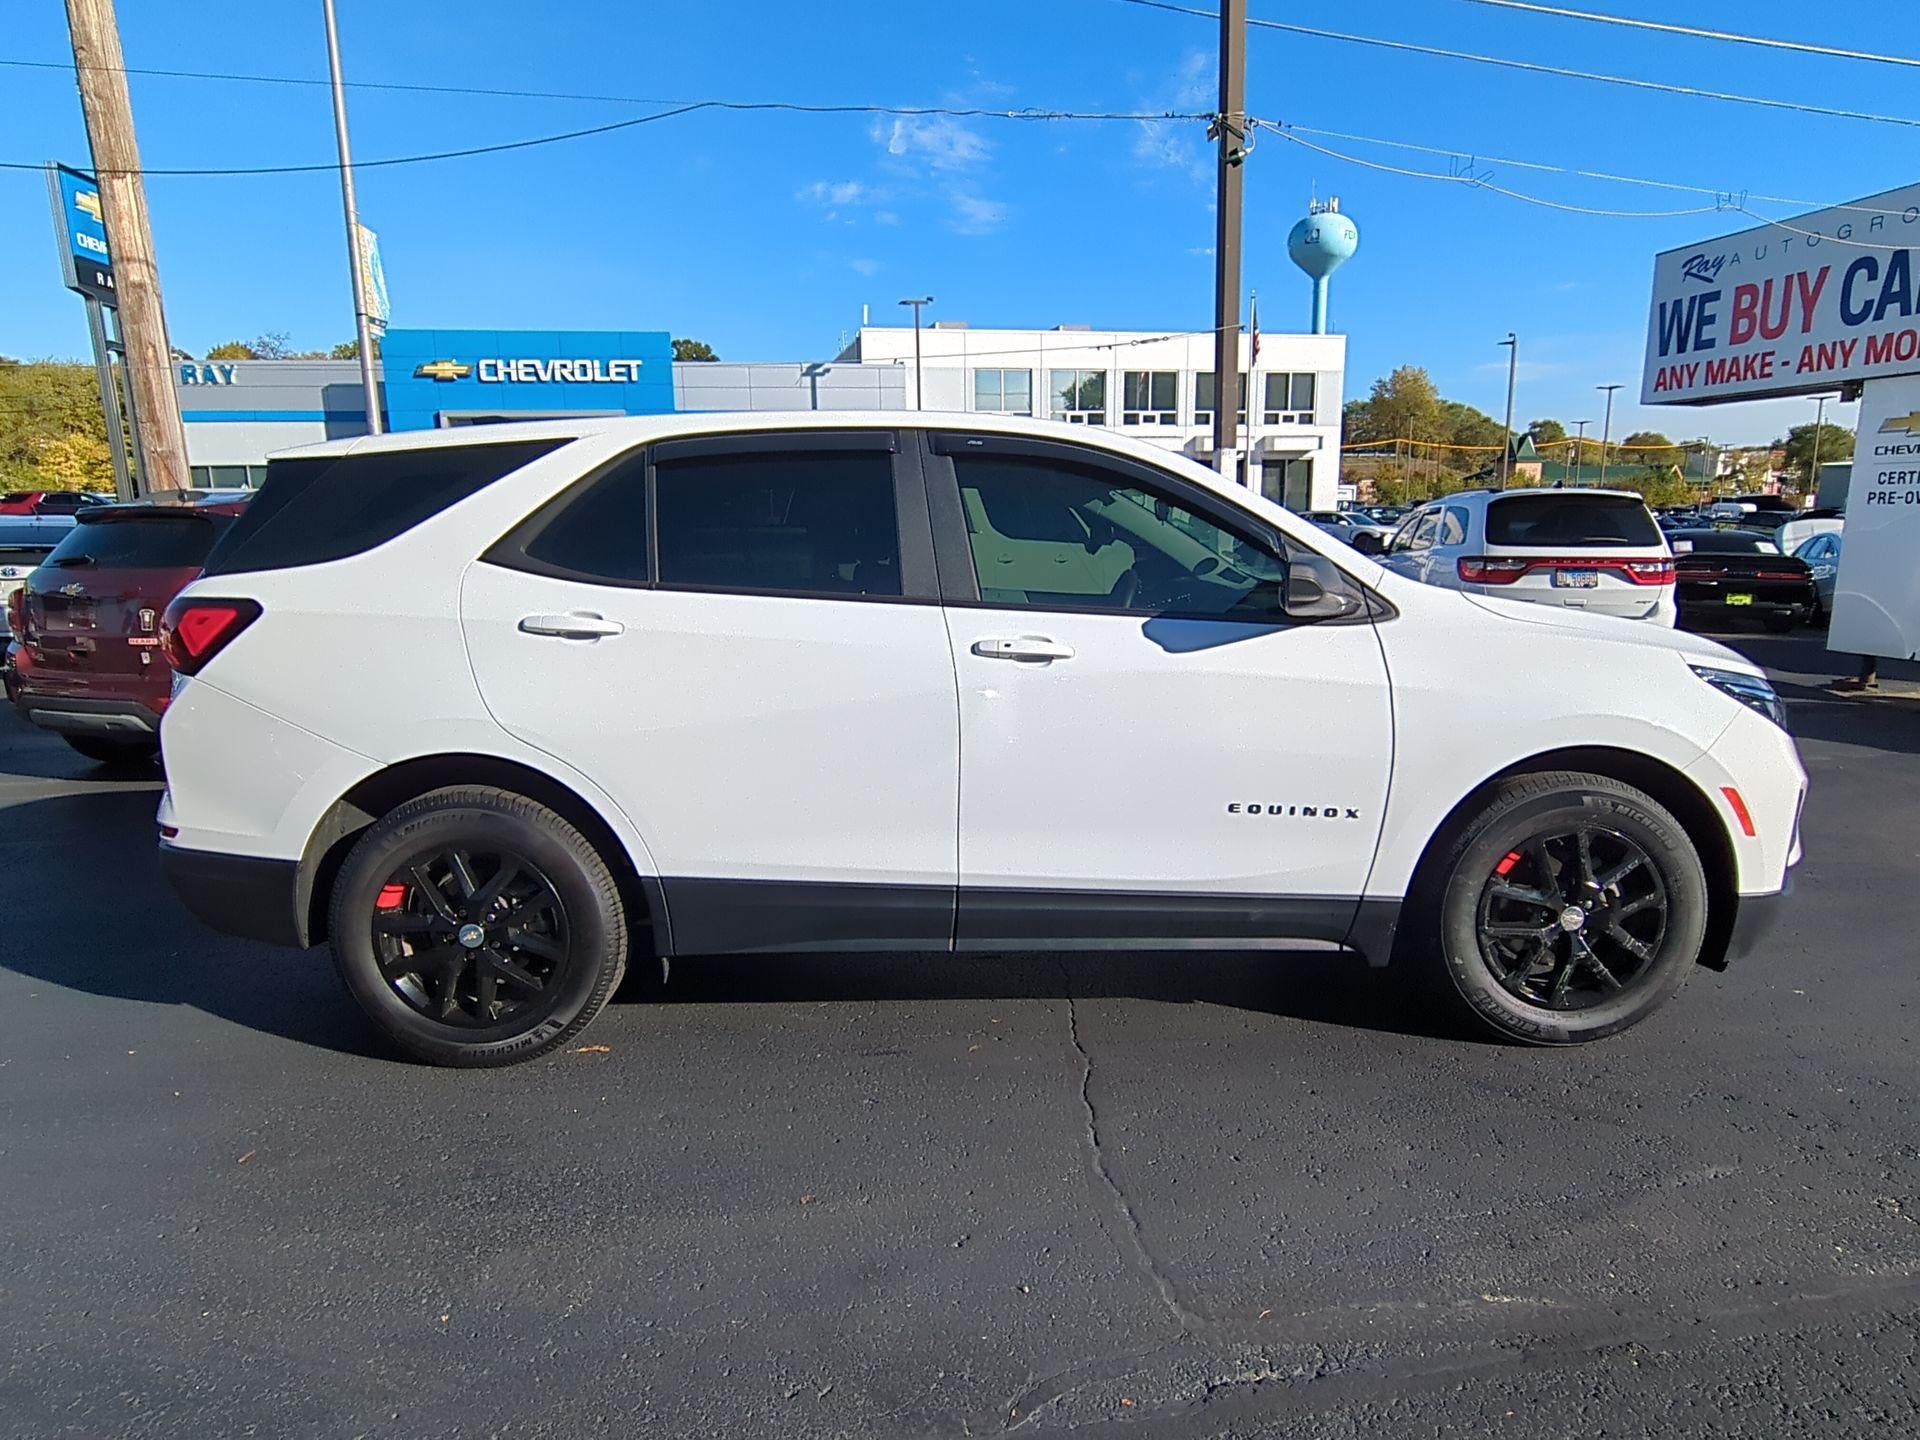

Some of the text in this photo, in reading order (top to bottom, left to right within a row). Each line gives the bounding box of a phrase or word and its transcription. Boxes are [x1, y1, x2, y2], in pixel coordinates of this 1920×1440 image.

[1682, 253, 1726, 283] Ray
[1658, 249, 1920, 357] WE BUY CA
[478, 358, 643, 383] CHEVROLET
[1653, 329, 1920, 393] ANY MAKE - ANY MO
[181, 364, 236, 385] RAY
[1874, 444, 1920, 456] CHEV
[1228, 802, 1359, 819] EQUINOX
